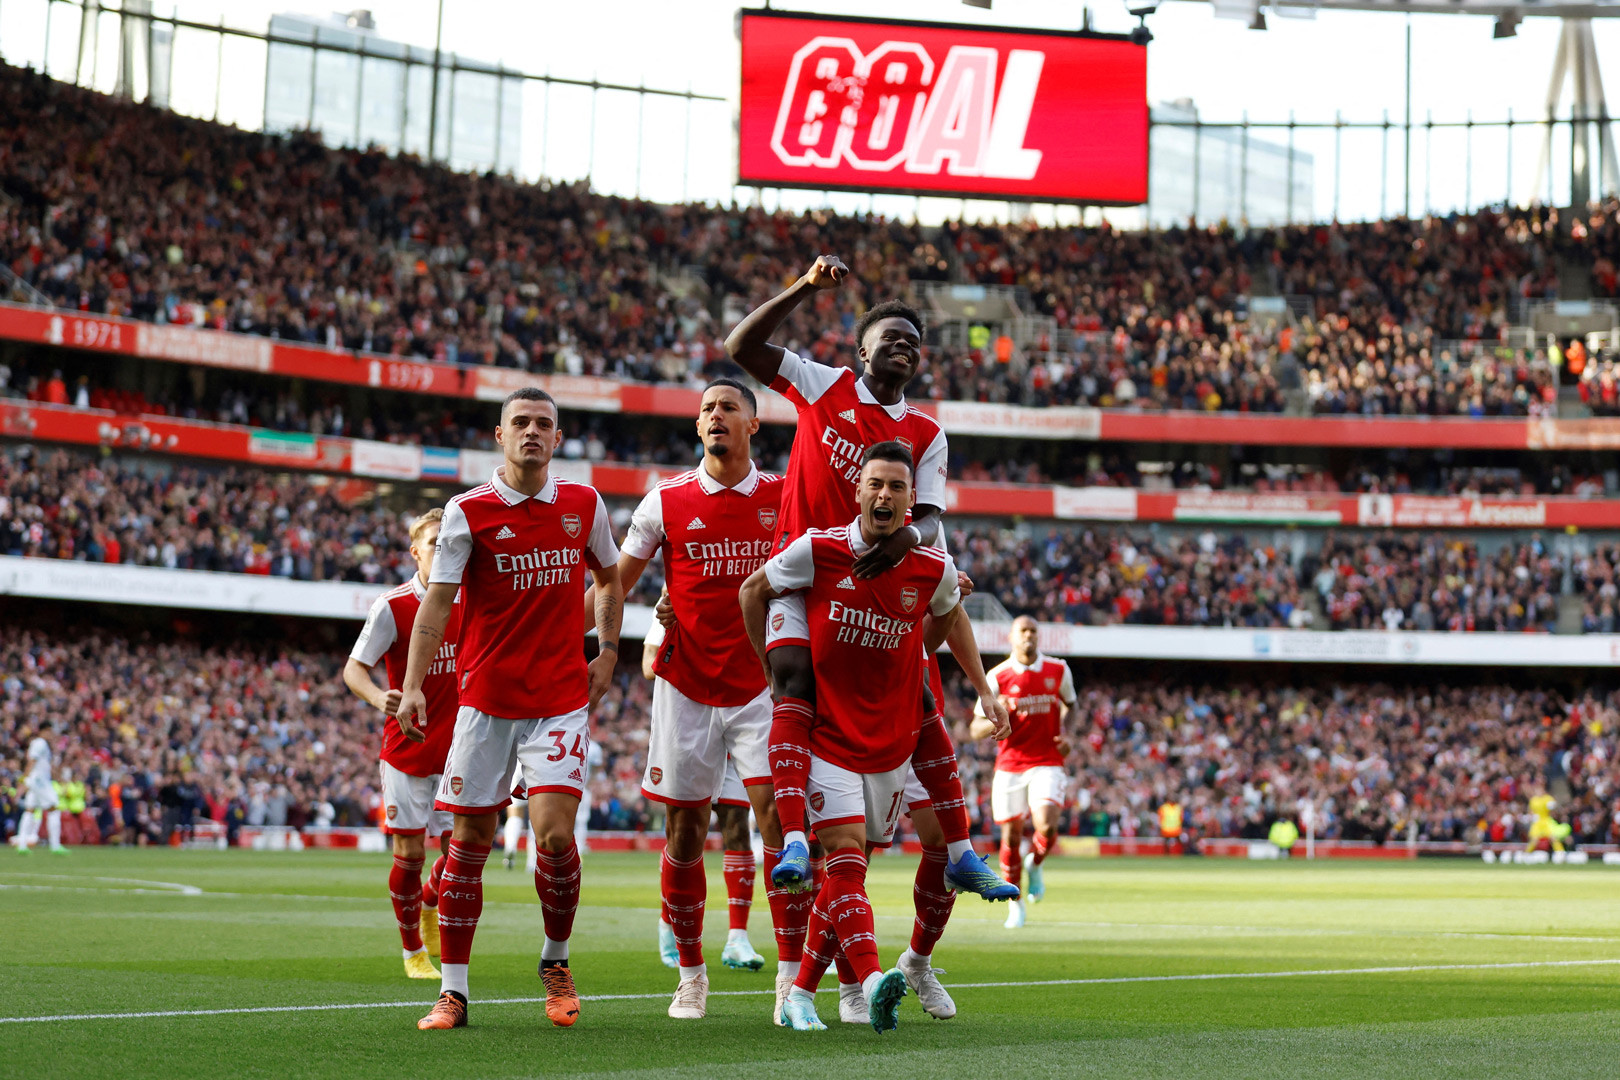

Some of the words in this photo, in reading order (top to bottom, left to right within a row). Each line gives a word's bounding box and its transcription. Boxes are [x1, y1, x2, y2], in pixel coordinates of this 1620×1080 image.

[770, 36, 1045, 180] GOAL
[75, 320, 121, 349] 1971
[494, 546, 581, 573] Emirates
[685, 537, 774, 560] Emirate
[702, 560, 722, 576] FLY
[513, 572, 533, 591] FLY
[828, 600, 914, 635] Emirates
[836, 626, 860, 644] FLY
[860, 631, 902, 650] BETTER
[546, 730, 586, 767] 34
[775, 759, 804, 770] AFC
[442, 890, 476, 901] AFC
[838, 907, 867, 923] AFC
